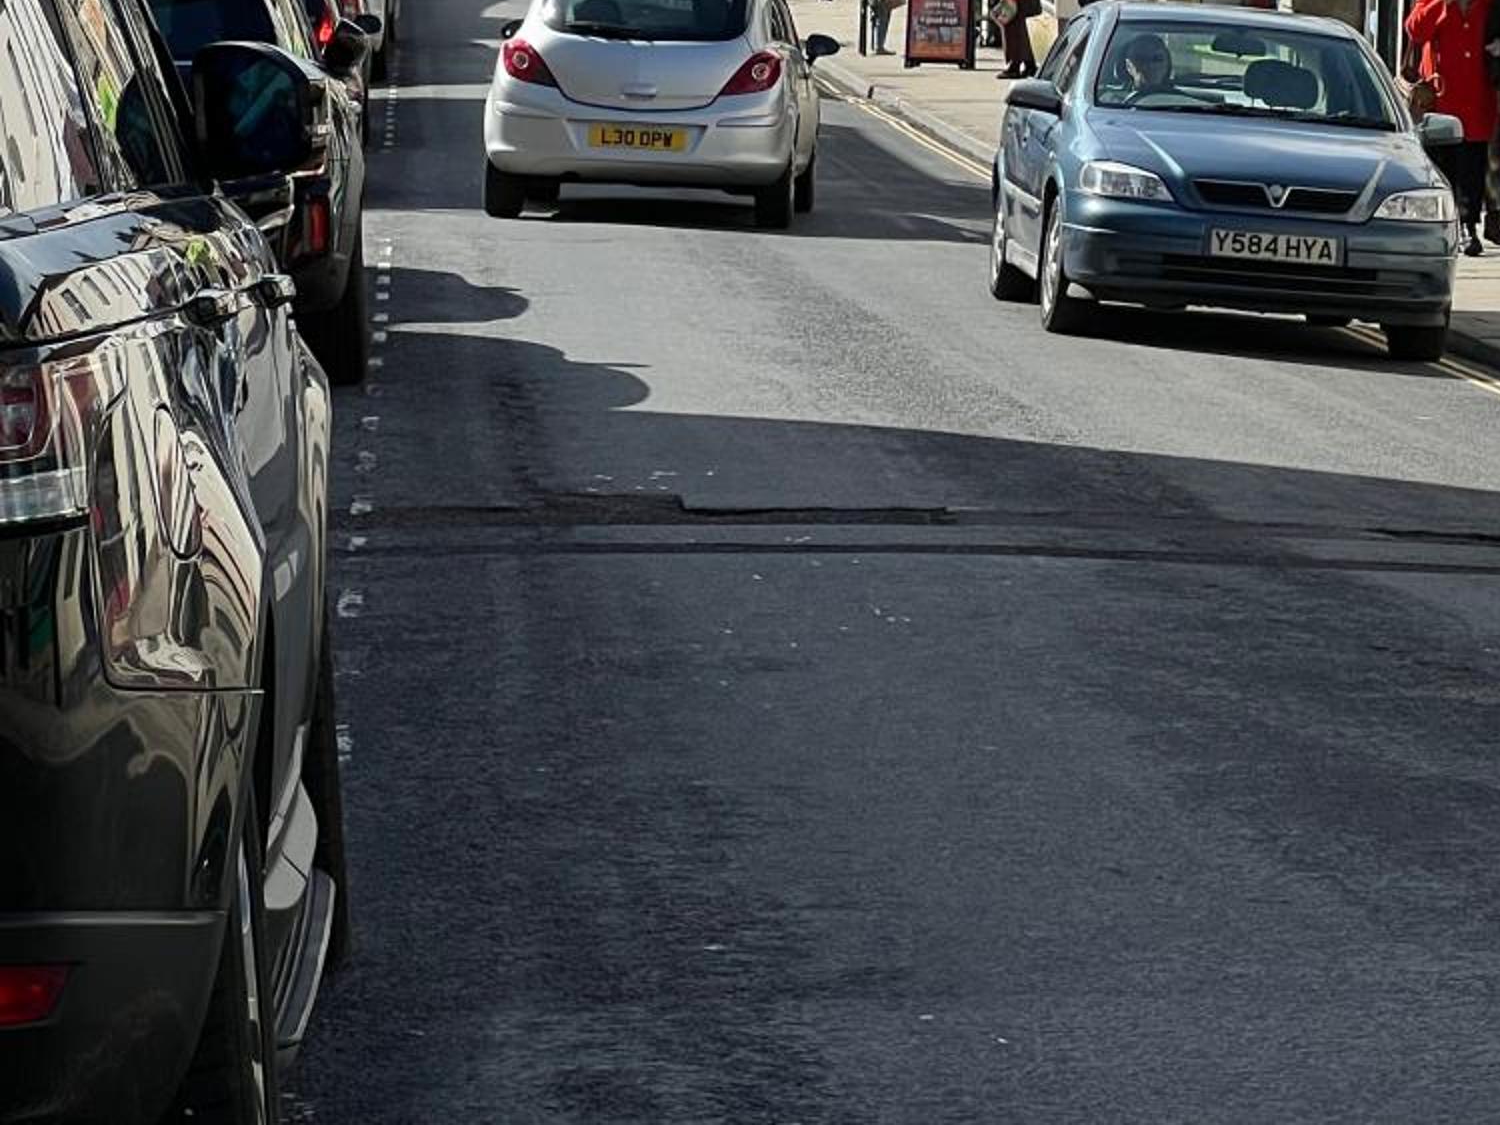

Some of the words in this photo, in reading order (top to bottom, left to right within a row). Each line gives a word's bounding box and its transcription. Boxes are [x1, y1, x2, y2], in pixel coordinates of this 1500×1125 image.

[601, 128, 635, 146] L30
[1215, 231, 1280, 256] Y584
[1285, 237, 1332, 261] HYA
